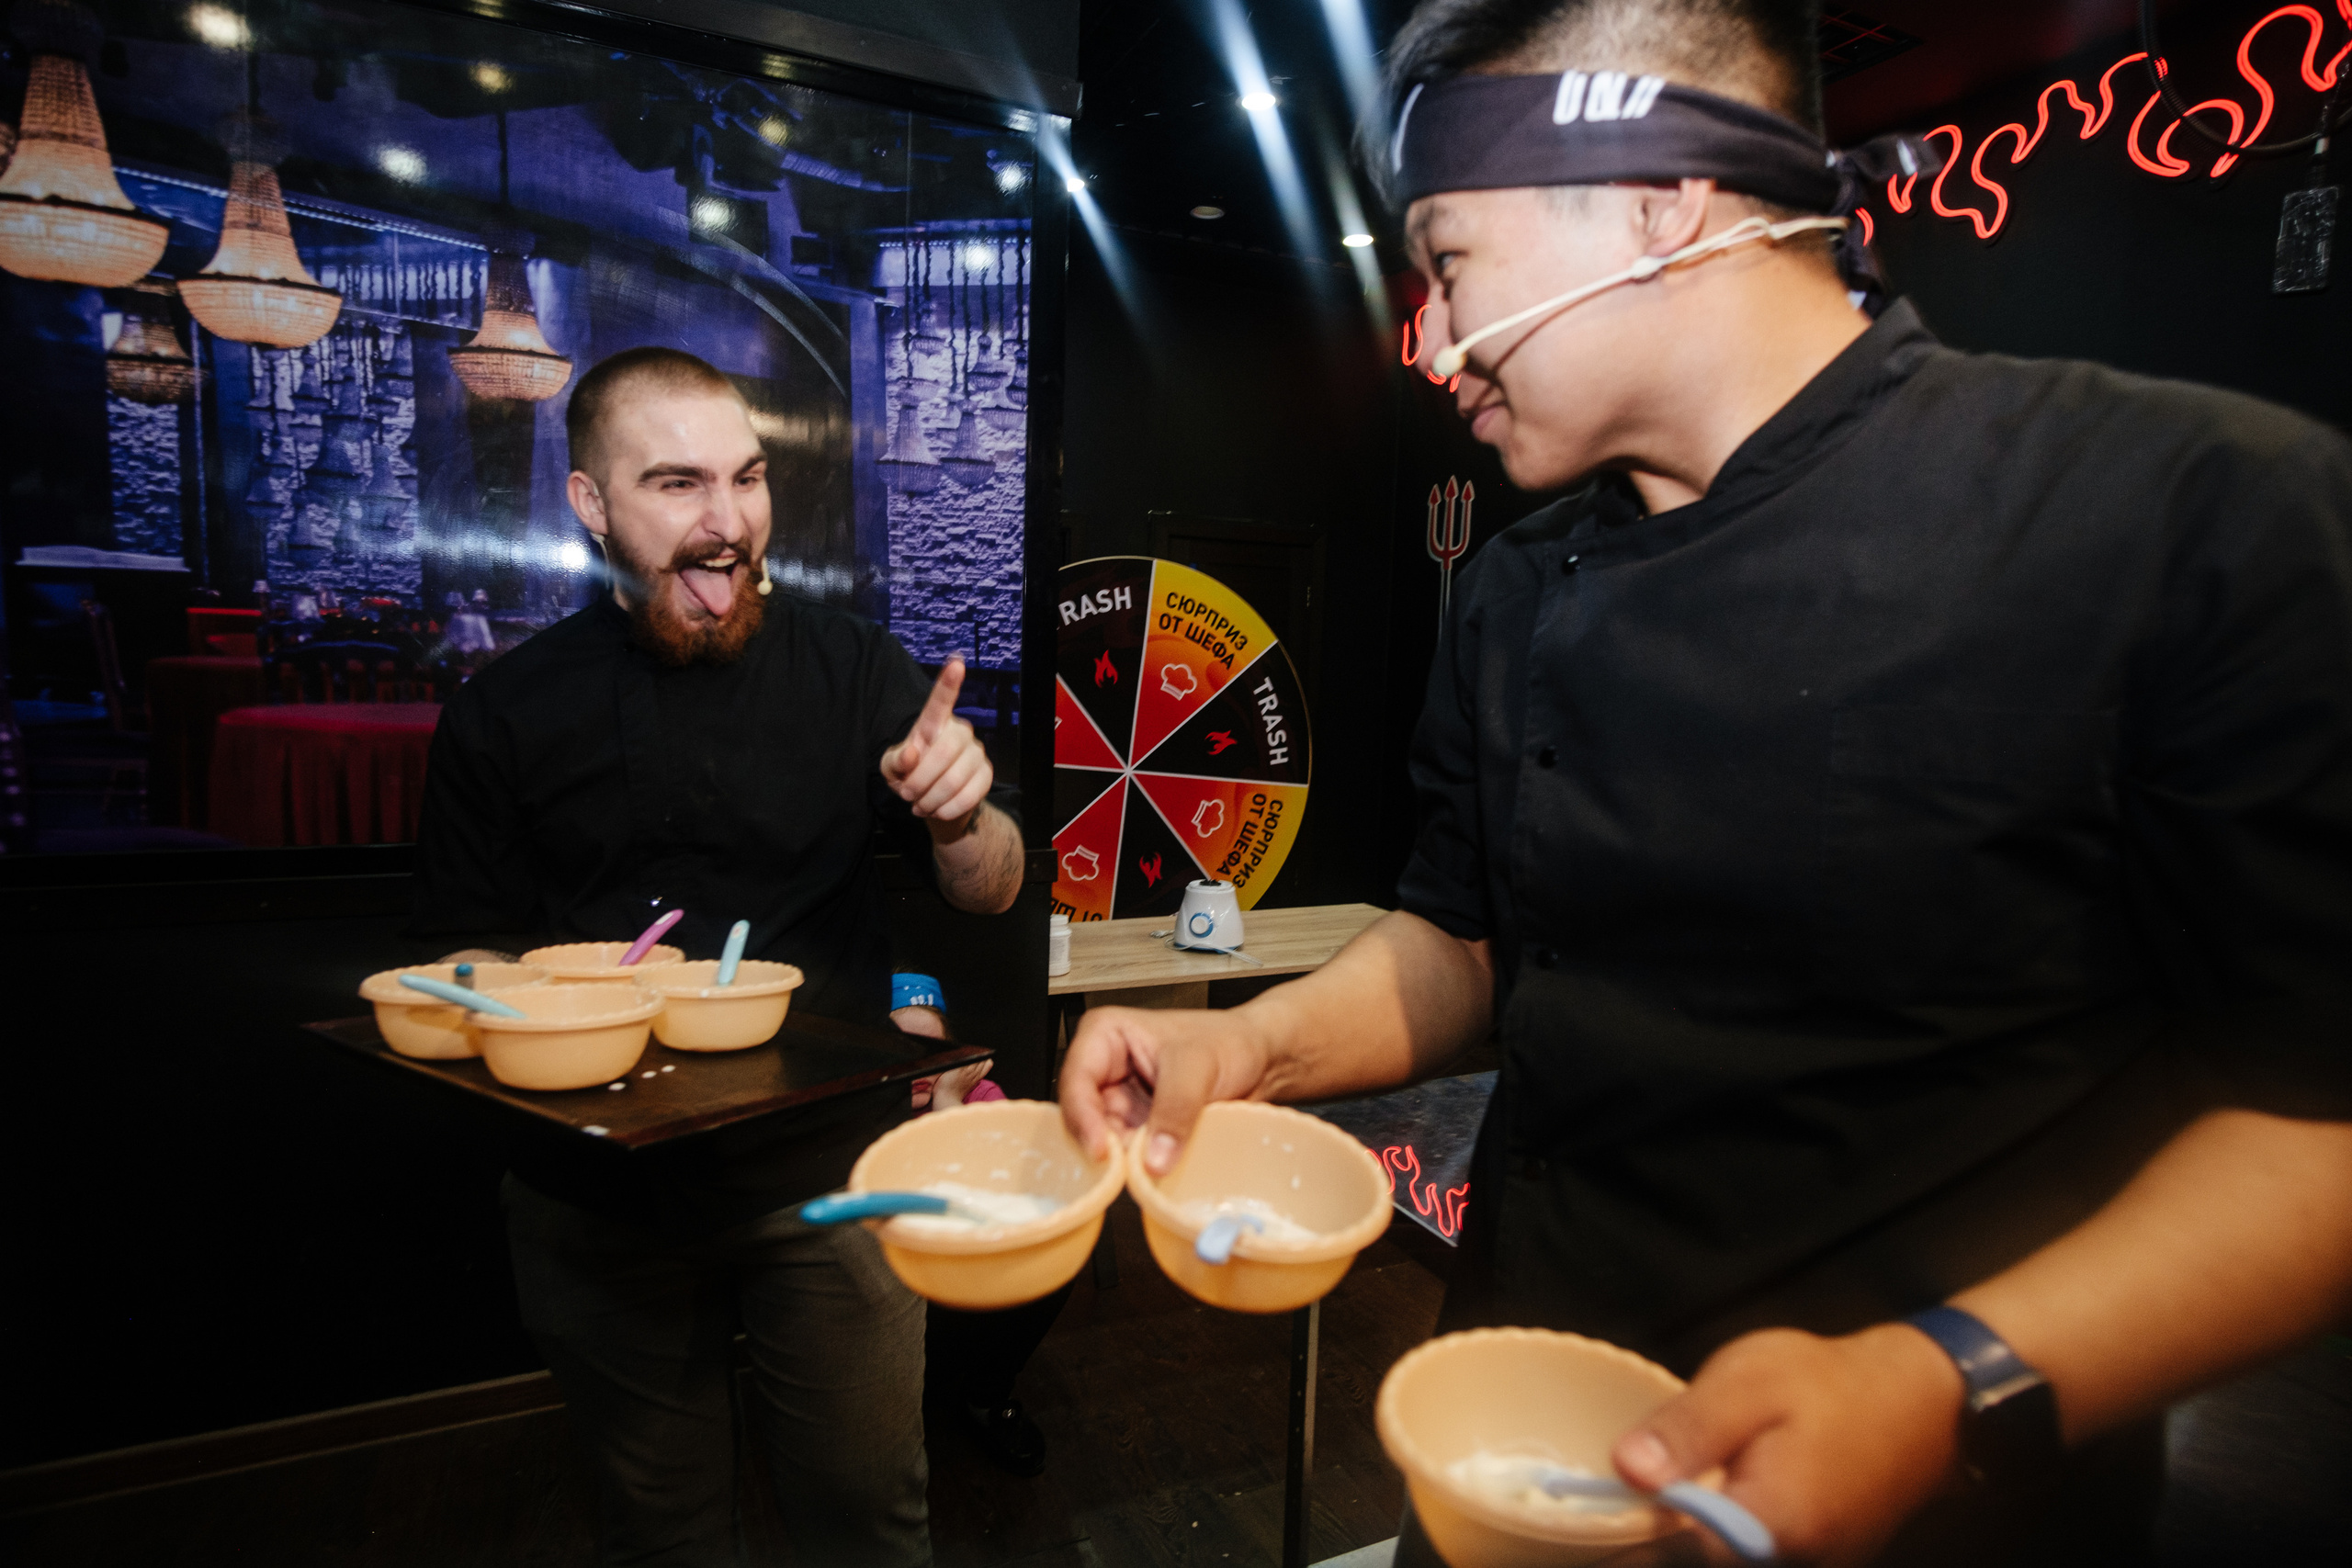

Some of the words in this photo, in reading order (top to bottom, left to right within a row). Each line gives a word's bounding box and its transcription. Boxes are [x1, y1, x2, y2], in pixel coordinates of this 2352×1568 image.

[1057, 586, 1131, 630] RASH
[1166, 592, 1248, 650] СЮРПРИЗ
[1159, 613, 1183, 633] ОТ
[1184, 622, 1235, 671] ШЕФА
[1253, 676, 1289, 765] TRASH
[1250, 794, 1266, 818] ОТ
[1216, 820, 1259, 875] ШЕФА
[1232, 799, 1283, 888] СЮРПРИЗ
